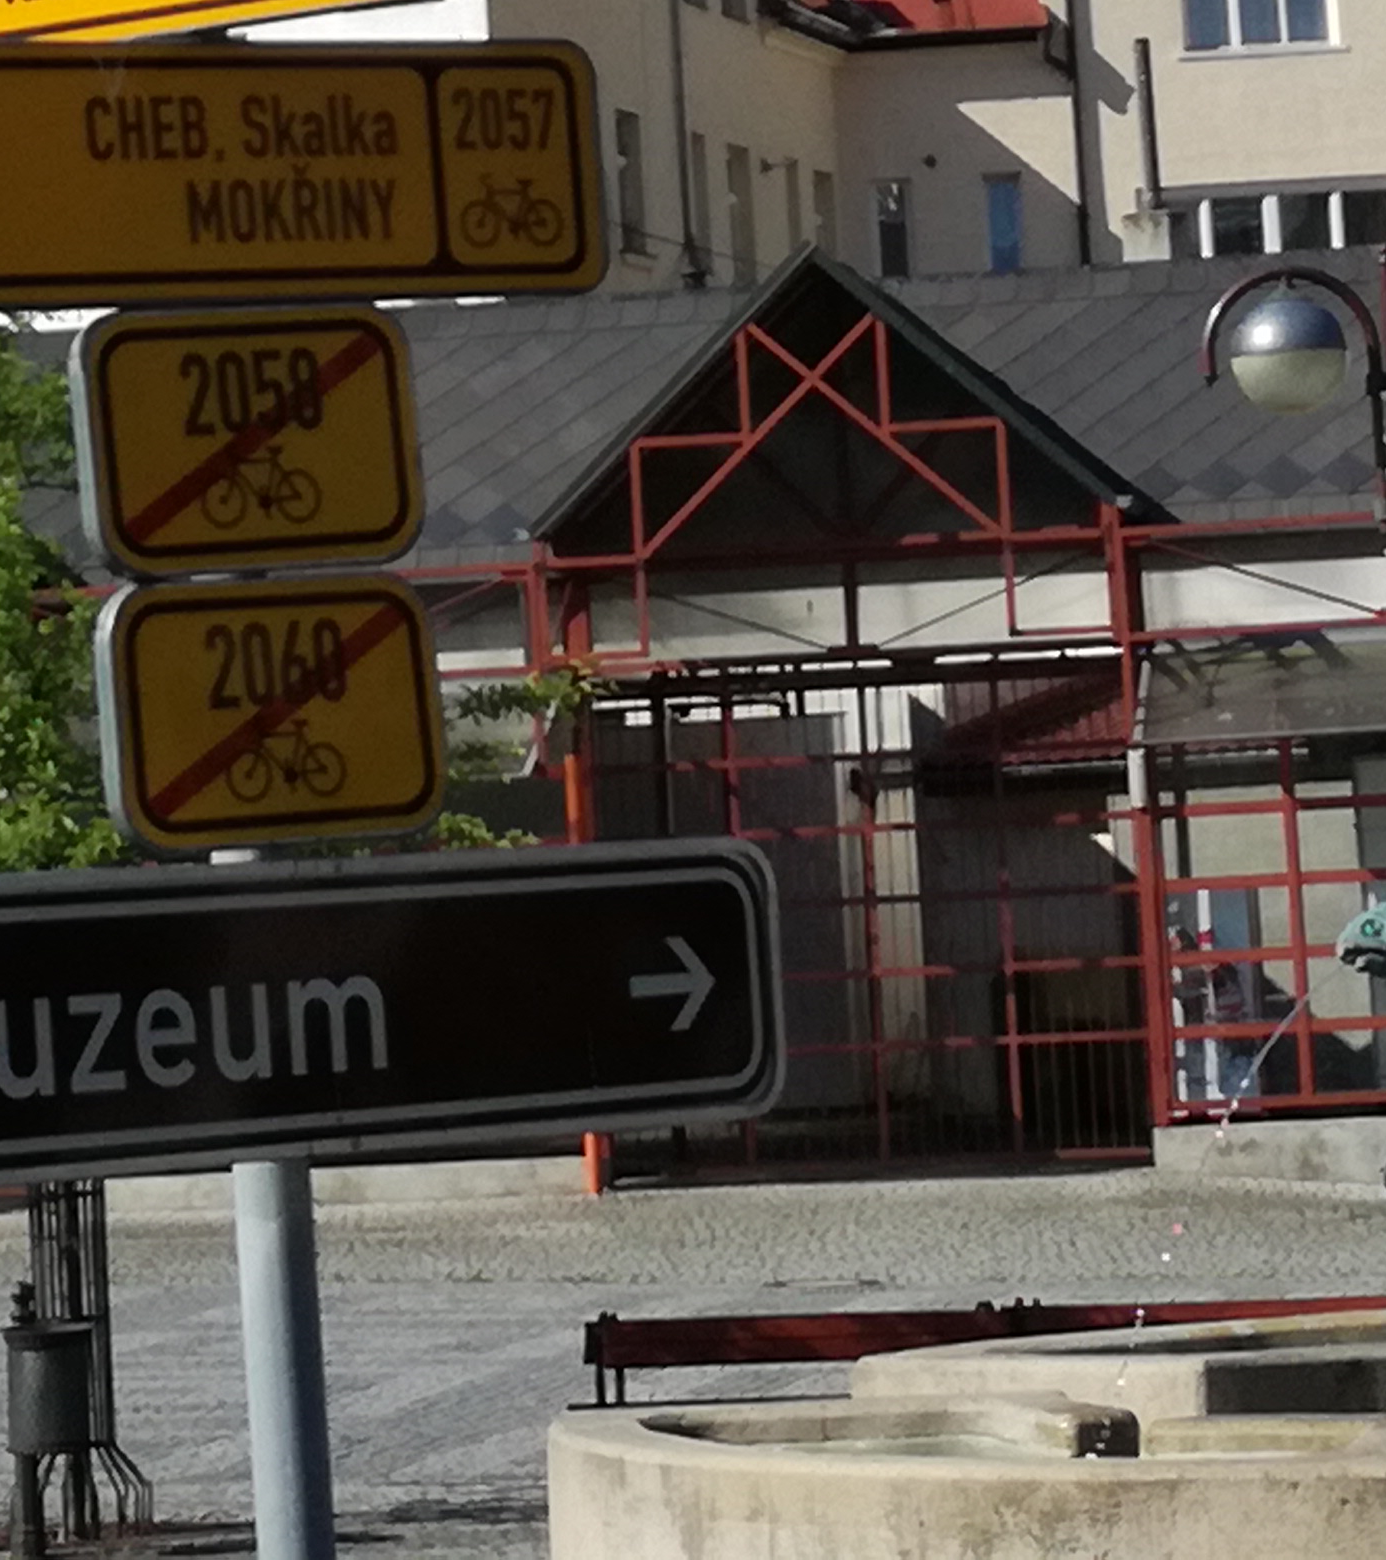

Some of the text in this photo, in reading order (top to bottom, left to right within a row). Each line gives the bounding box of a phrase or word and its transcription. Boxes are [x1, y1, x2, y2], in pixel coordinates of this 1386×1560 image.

[241, 94, 399, 158] Skalka
[451, 88, 556, 151] 2057
[186, 162, 396, 243] MOKŘINY
[180, 350, 324, 436] 2058
[208, 618, 348, 711] 2060
